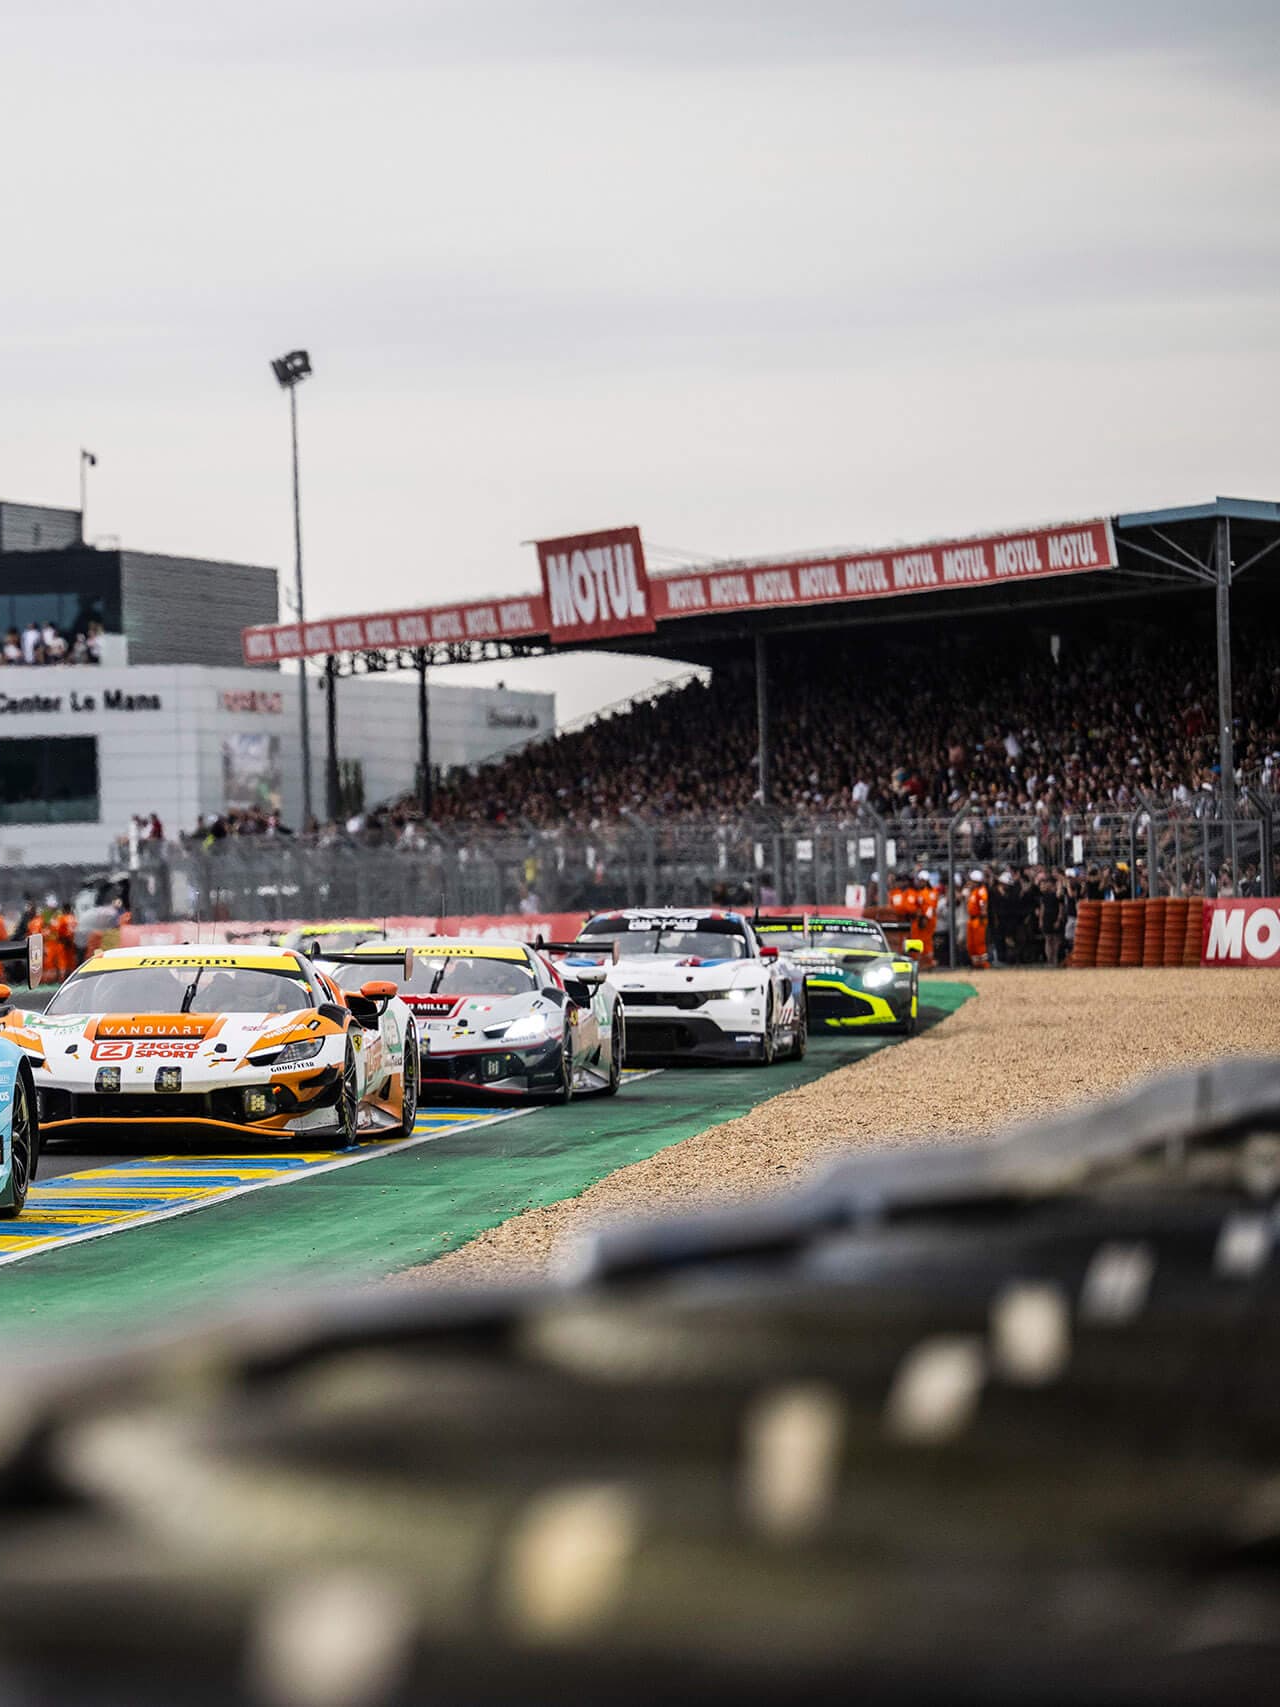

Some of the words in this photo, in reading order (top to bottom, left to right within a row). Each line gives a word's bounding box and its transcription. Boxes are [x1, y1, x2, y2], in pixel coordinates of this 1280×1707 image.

[798, 564, 842, 596] MOTUL
[845, 560, 888, 592] MOTUL
[892, 553, 938, 588] MOTUL
[942, 546, 989, 582] MOTUL
[994, 538, 1042, 576] MOTUL
[1047, 532, 1098, 569] MOTUL
[546, 543, 646, 627] MOTUL
[70, 691, 95, 712] Le
[104, 690, 161, 711] Mans
[1206, 907, 1280, 960] MO
[105, 1025, 204, 1034] VANGUART
[135, 1050, 198, 1059] SPORT
[137, 1042, 200, 1050] ZIGGO
